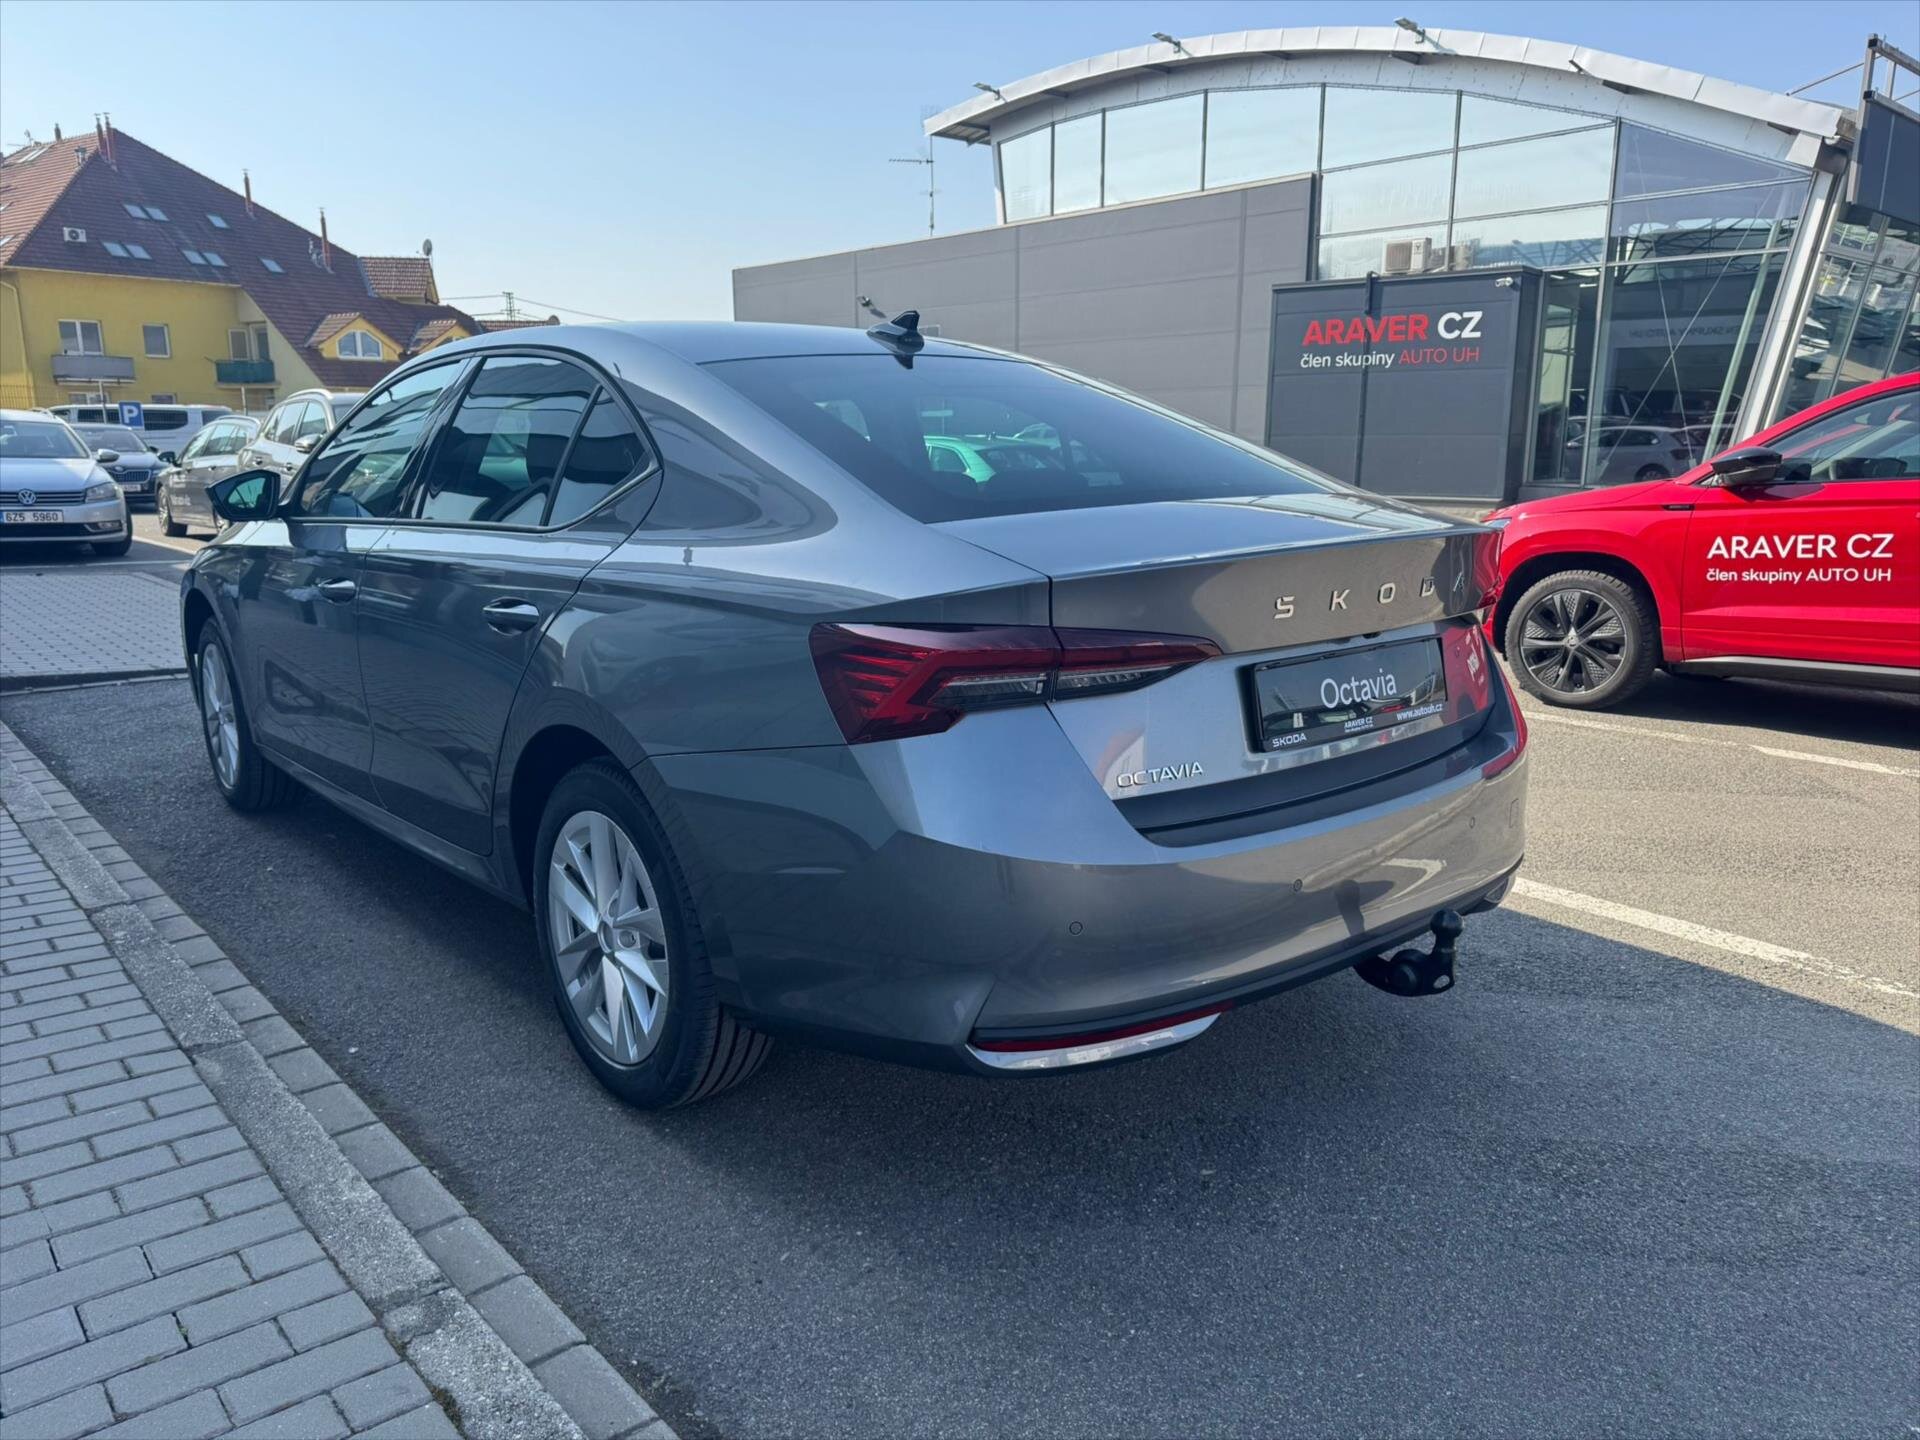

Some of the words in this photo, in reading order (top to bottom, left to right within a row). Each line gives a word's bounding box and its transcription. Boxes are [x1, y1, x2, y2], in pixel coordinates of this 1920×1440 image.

[1302, 313, 1429, 347] ARAVER
[1437, 311, 1483, 339] CZ
[1300, 353, 1331, 368] člen
[1335, 351, 1395, 369] skupiny
[1399, 348, 1448, 364] AUTO
[1453, 347, 1480, 363] UH
[122, 405, 139, 424] P
[33, 512, 58, 521] 5960
[1706, 534, 1838, 559] ARAVER
[1847, 533, 1894, 558] CZ
[1706, 568, 1738, 582] člen
[1742, 568, 1802, 584] skupiny
[1806, 568, 1859, 582] AUTO
[1864, 568, 1892, 582] UH
[1320, 668, 1397, 709] Octavia
[1116, 761, 1204, 788] OCTAVIA
